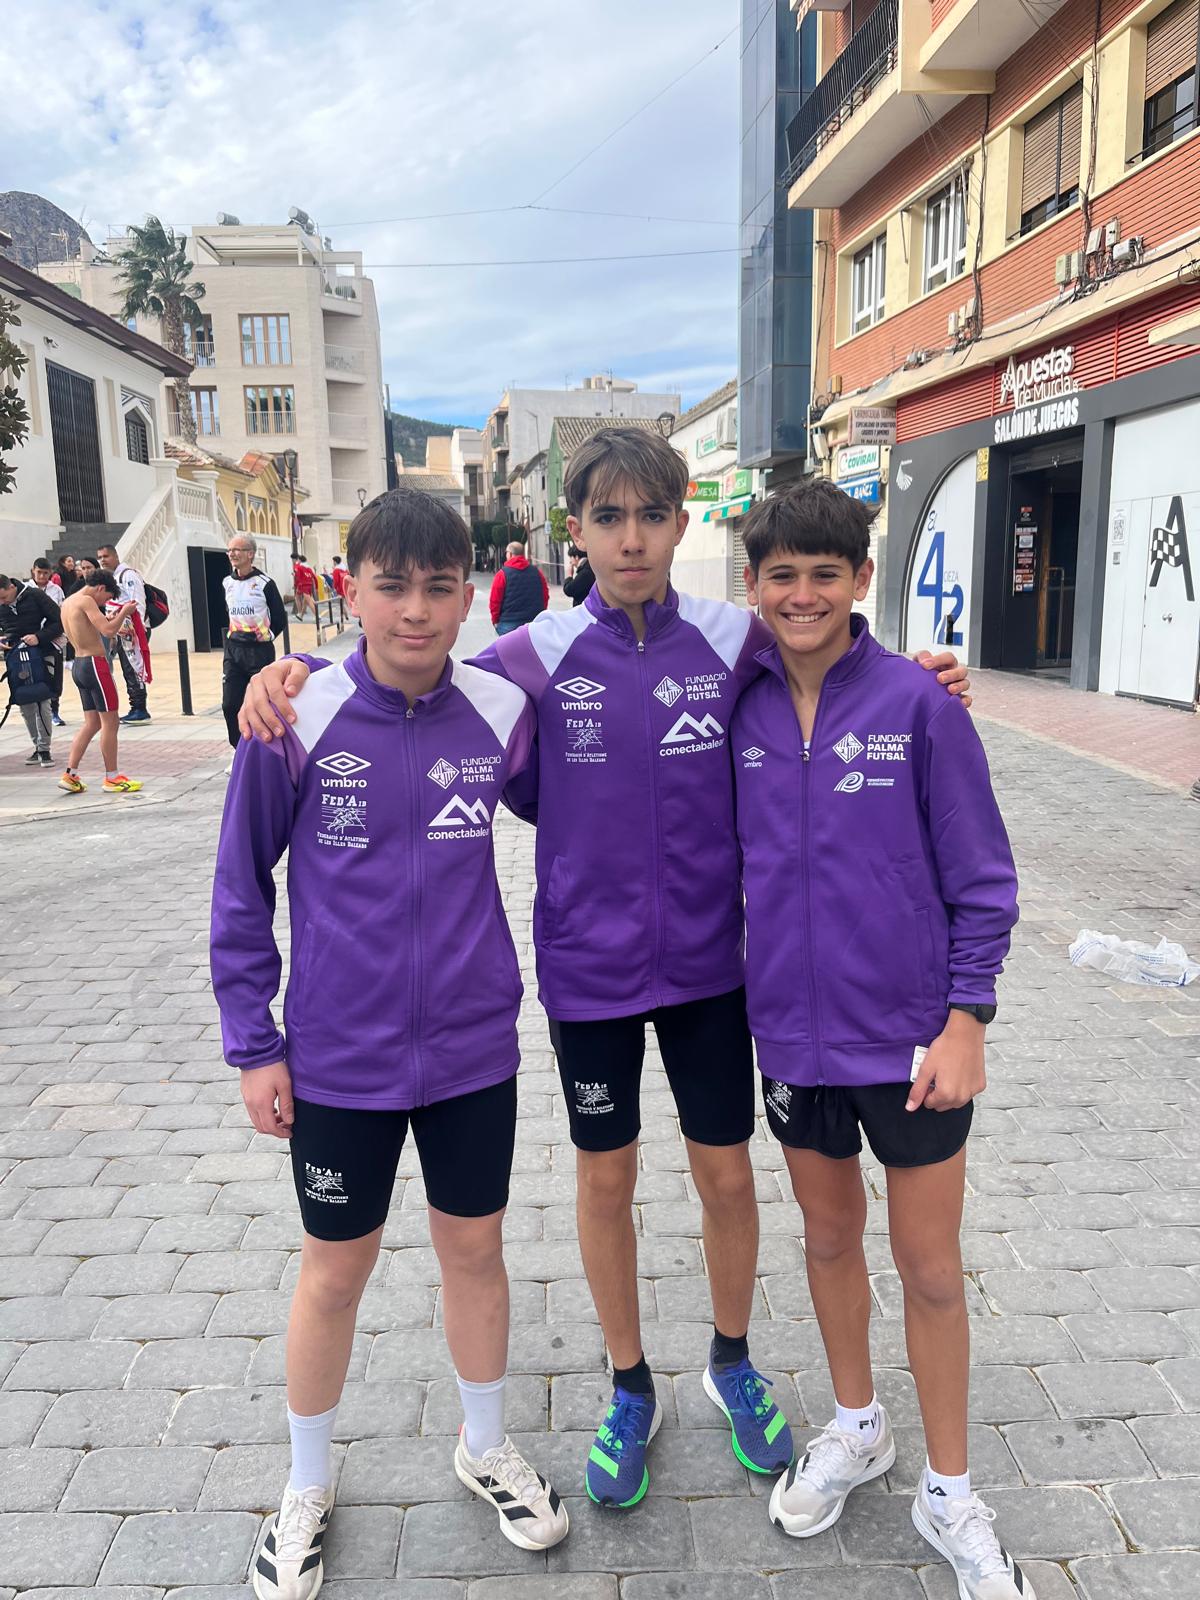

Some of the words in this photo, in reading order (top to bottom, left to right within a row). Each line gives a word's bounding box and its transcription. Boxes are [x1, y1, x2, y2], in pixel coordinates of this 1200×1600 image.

[1001, 346, 1073, 408] Apuestas
[1033, 374, 1072, 403] Murcia
[1024, 408, 1038, 437] DE
[1037, 397, 1079, 435] JUEGOS
[685, 671, 726, 684] FUNDACIÓ
[686, 682, 719, 693] PALMA
[687, 690, 721, 701] FUTSAL
[561, 700, 602, 710] umbro
[867, 743, 904, 752] PALMA
[461, 755, 502, 767] FUNDACIÓ
[866, 751, 906, 761] FUTSAL
[462, 766, 493, 775] PALMA
[321, 777, 367, 788] umbro
[463, 774, 495, 783] FUTSAL
